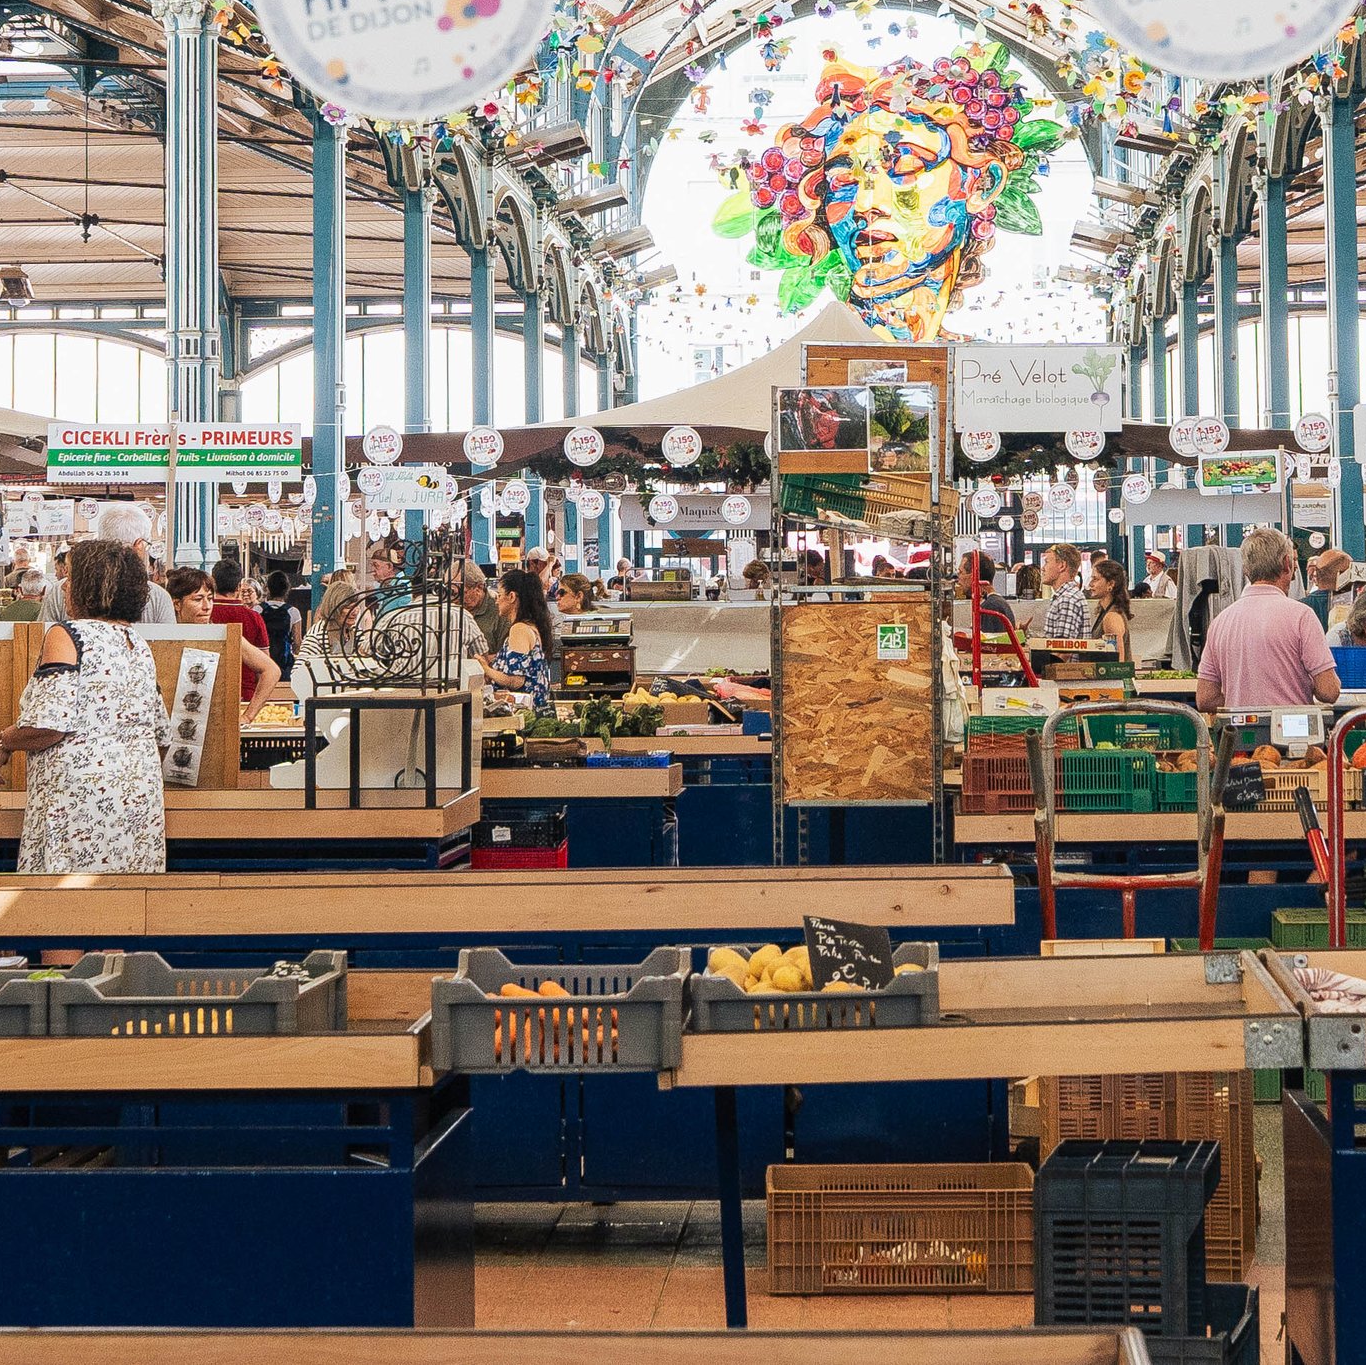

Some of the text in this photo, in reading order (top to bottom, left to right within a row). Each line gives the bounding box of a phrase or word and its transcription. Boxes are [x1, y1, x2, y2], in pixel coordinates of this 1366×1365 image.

[307, 1, 434, 42] DE DIJON
[961, 359, 1067, 386] Pré Velot
[961, 389, 1089, 406] Maraîchage biologique
[1205, 425, 1221, 434] 150
[1309, 421, 1326, 431] 150
[62, 430, 129, 446] CICEKLI
[202, 430, 293, 446] PRIMEURS
[379, 434, 394, 443] 150
[480, 434, 495, 444] 150
[580, 436, 595, 444] 150
[678, 435, 694, 444] 150
[58, 453, 92, 463] Epicerie
[93, 453, 111, 463] fine
[118, 453, 161, 462] Corbeilles
[176, 453, 200, 463] fruits
[249, 452, 255, 462] à
[257, 453, 295, 462] domicile
[411, 491, 443, 504] JURA
[881, 632, 902, 649] AB
[1046, 640, 1087, 649] PHILIBON
